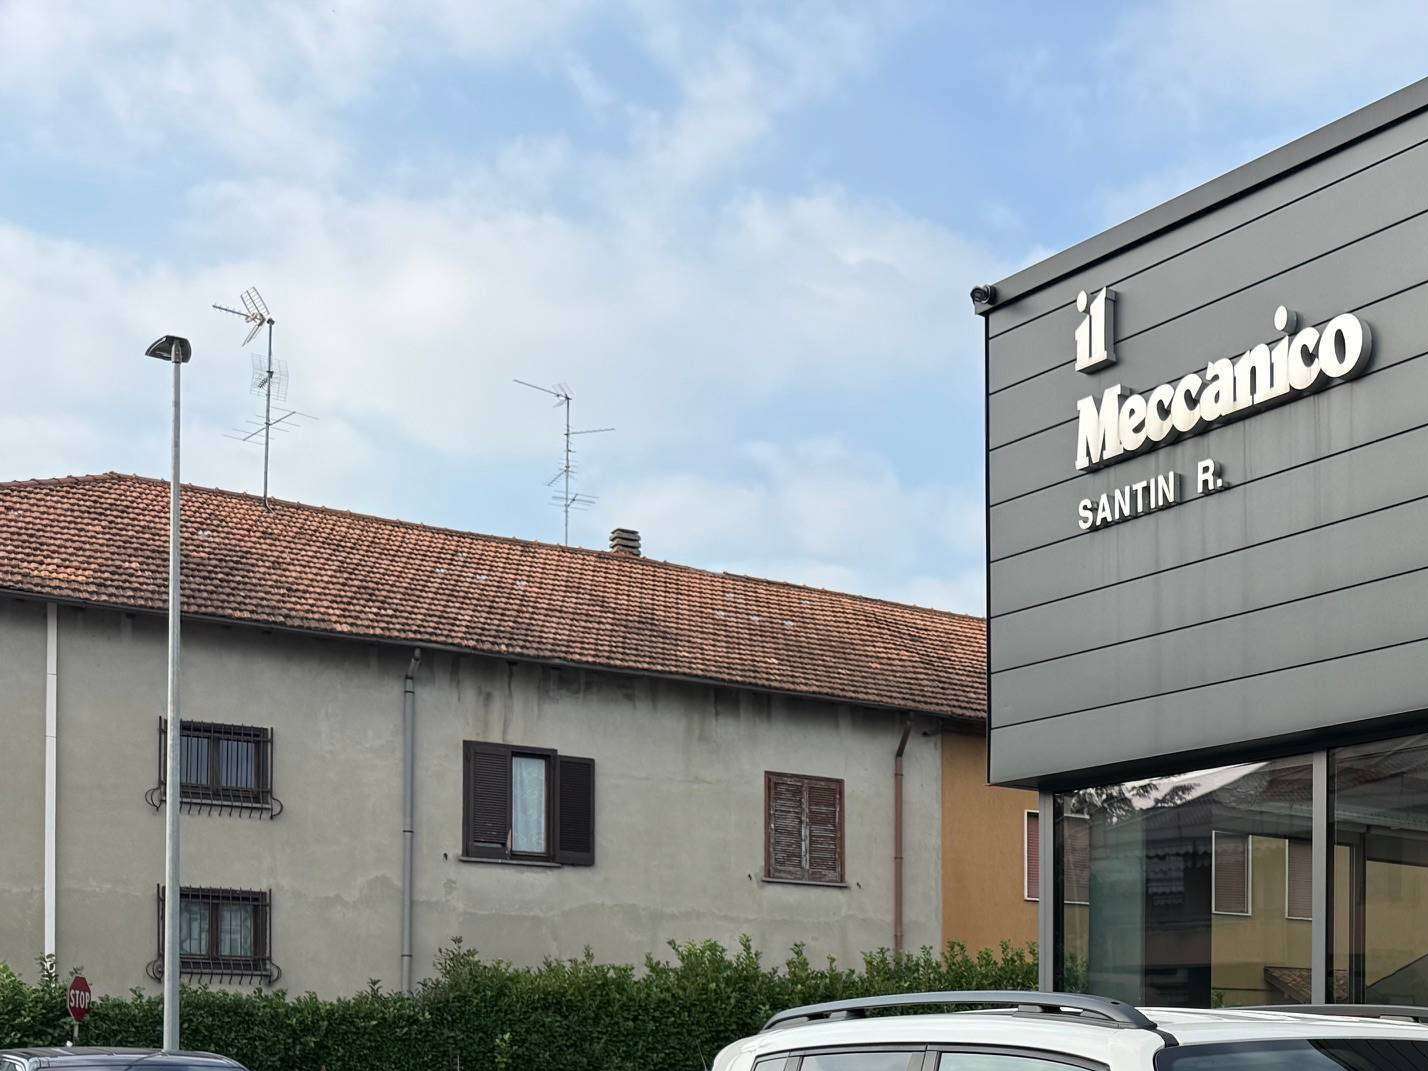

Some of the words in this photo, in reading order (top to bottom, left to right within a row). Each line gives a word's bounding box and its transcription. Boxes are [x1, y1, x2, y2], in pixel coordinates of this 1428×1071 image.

[1074, 286, 1116, 374] il
[1074, 304, 1372, 472] Meccanico
[1077, 470, 1180, 531] SANTIN
[1197, 457, 1227, 495] R.
[70, 989, 91, 1009] STOP
